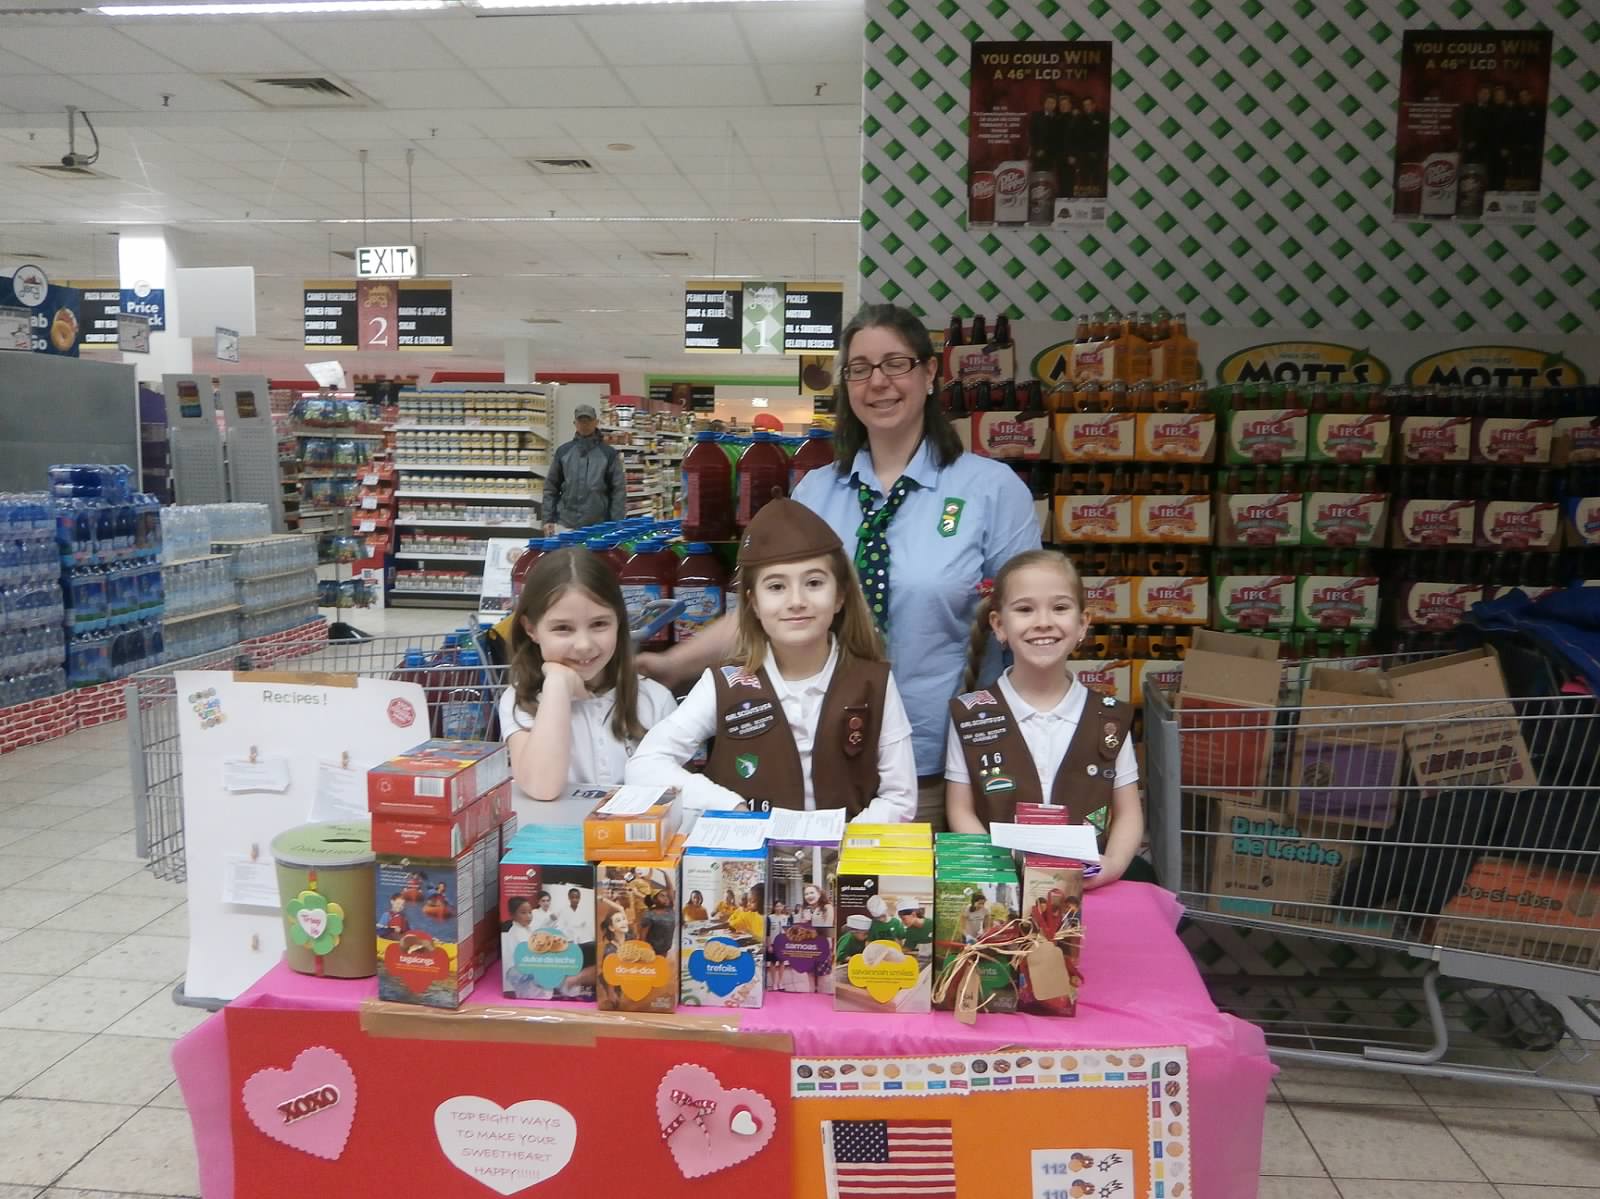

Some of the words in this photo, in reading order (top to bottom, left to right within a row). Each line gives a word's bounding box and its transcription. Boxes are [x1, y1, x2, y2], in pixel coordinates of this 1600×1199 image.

[1413, 42, 1443, 54] YOU
[1447, 42, 1497, 54] COULD
[981, 54, 1009, 65] YOU
[1012, 54, 1060, 65] COULD
[1063, 50, 1101, 64] WIN
[1469, 59, 1497, 70] LCD
[993, 69, 1003, 80] A
[1034, 69, 1062, 80] LCD
[359, 248, 409, 274] EXIT
[127, 302, 159, 313] Price
[368, 316, 388, 347] 2
[754, 319, 769, 347] 1
[1256, 424, 1280, 435] IBC
[1231, 816, 1302, 838] Dulce
[1265, 838, 1343, 867] Leche
[785, 943, 818, 951] samoas
[615, 965, 657, 976] do-si-dos
[706, 963, 737, 973] trefoils
[277, 1087, 339, 1123] XOXO
[450, 1111, 476, 1121] TOP
[478, 1112, 519, 1126] EIGHT
[520, 1116, 562, 1131] WAYS
[455, 1129, 475, 1140] TO
[476, 1131, 516, 1142] MAKE
[519, 1134, 558, 1147] YOUR
[461, 1147, 553, 1162] SWEETHEART
[1041, 1163, 1068, 1175] 112
